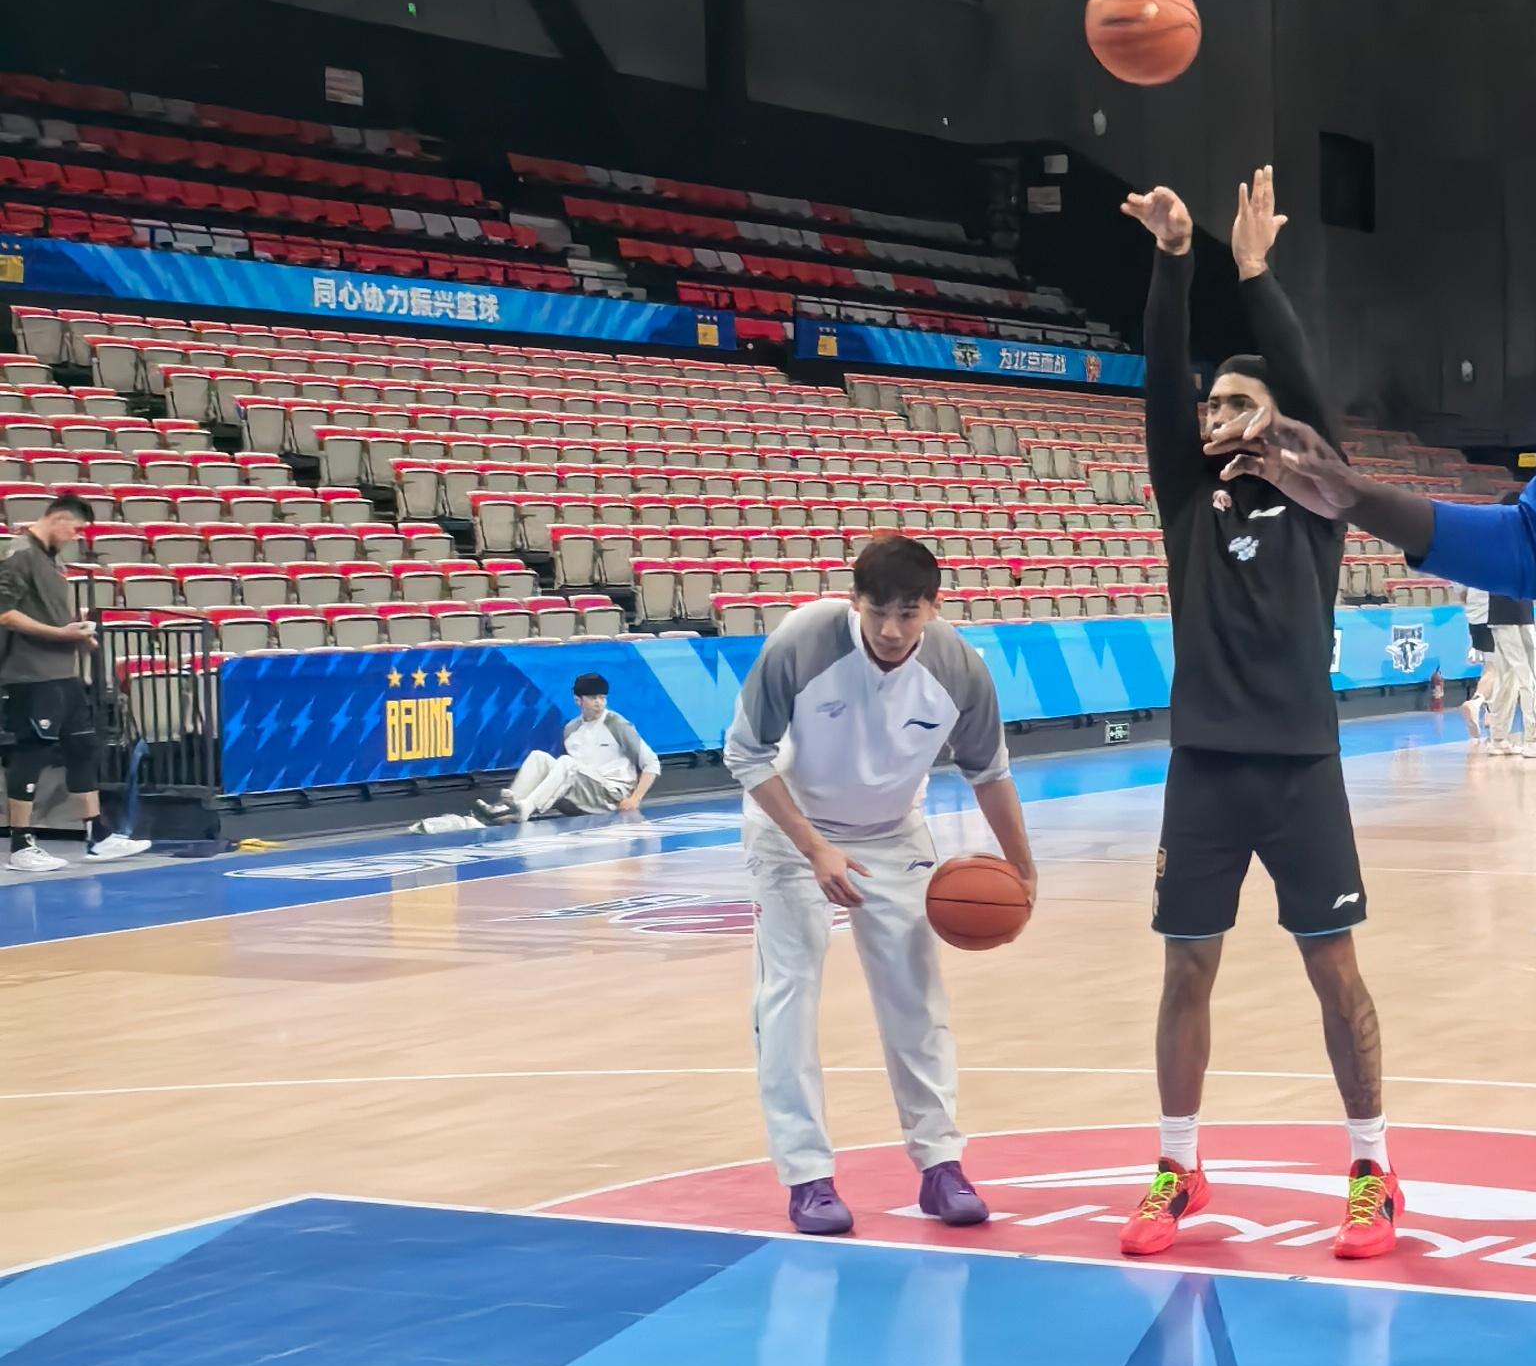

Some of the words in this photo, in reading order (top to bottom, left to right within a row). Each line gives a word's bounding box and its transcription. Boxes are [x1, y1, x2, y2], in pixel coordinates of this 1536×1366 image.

[313, 276, 500, 323] 同心协力振兴篮球
[386, 697, 454, 762] BEIJING
